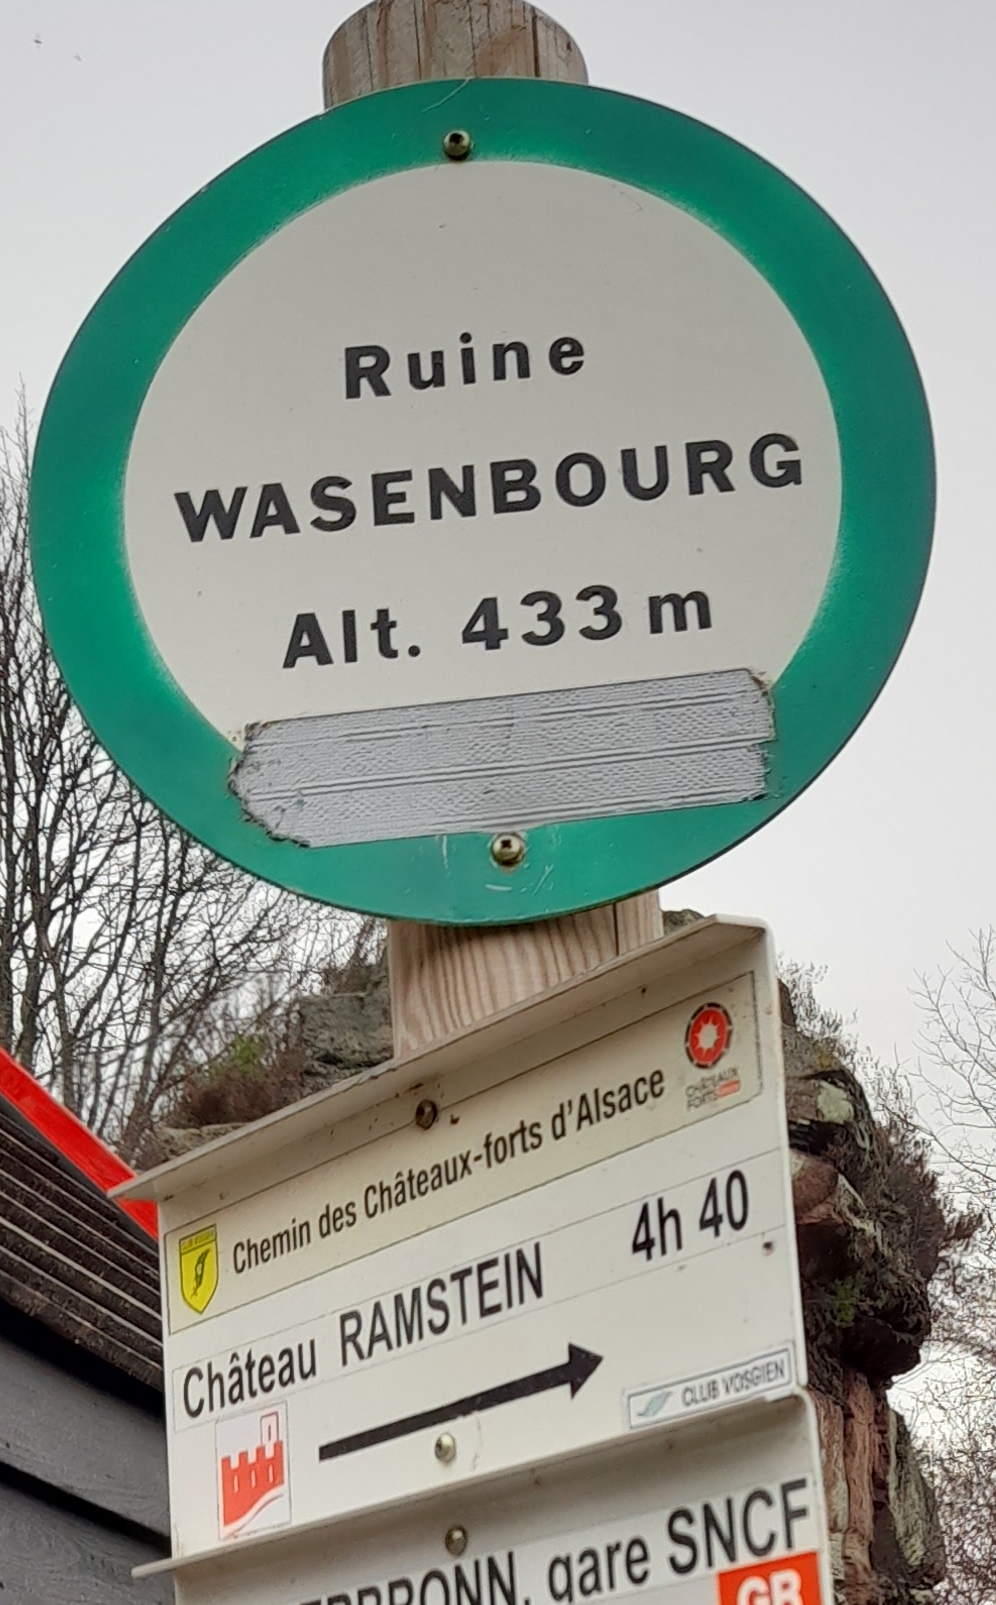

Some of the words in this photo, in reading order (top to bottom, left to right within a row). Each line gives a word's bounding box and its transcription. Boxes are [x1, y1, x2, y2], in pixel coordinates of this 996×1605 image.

[344, 331, 586, 400] Ruine
[173, 432, 803, 543] WASENBOURG
[282, 608, 421, 669] Alt.
[461, 584, 623, 651] 433
[648, 590, 712, 635] m
[233, 1217, 311, 1274] Chemin
[318, 1201, 358, 1239] des
[363, 1119, 543, 1219] Châteaux-forts
[550, 1069, 665, 1141] d'Alsace
[183, 1339, 316, 1418] Château
[339, 1242, 543, 1366] RAMSTEIN
[631, 1197, 683, 1261] 4h
[699, 1169, 749, 1238] 40
[681, 1378, 719, 1406] CLUB
[722, 1359, 784, 1395] VOSGIEN
[667, 1478, 808, 1575] SNCF
